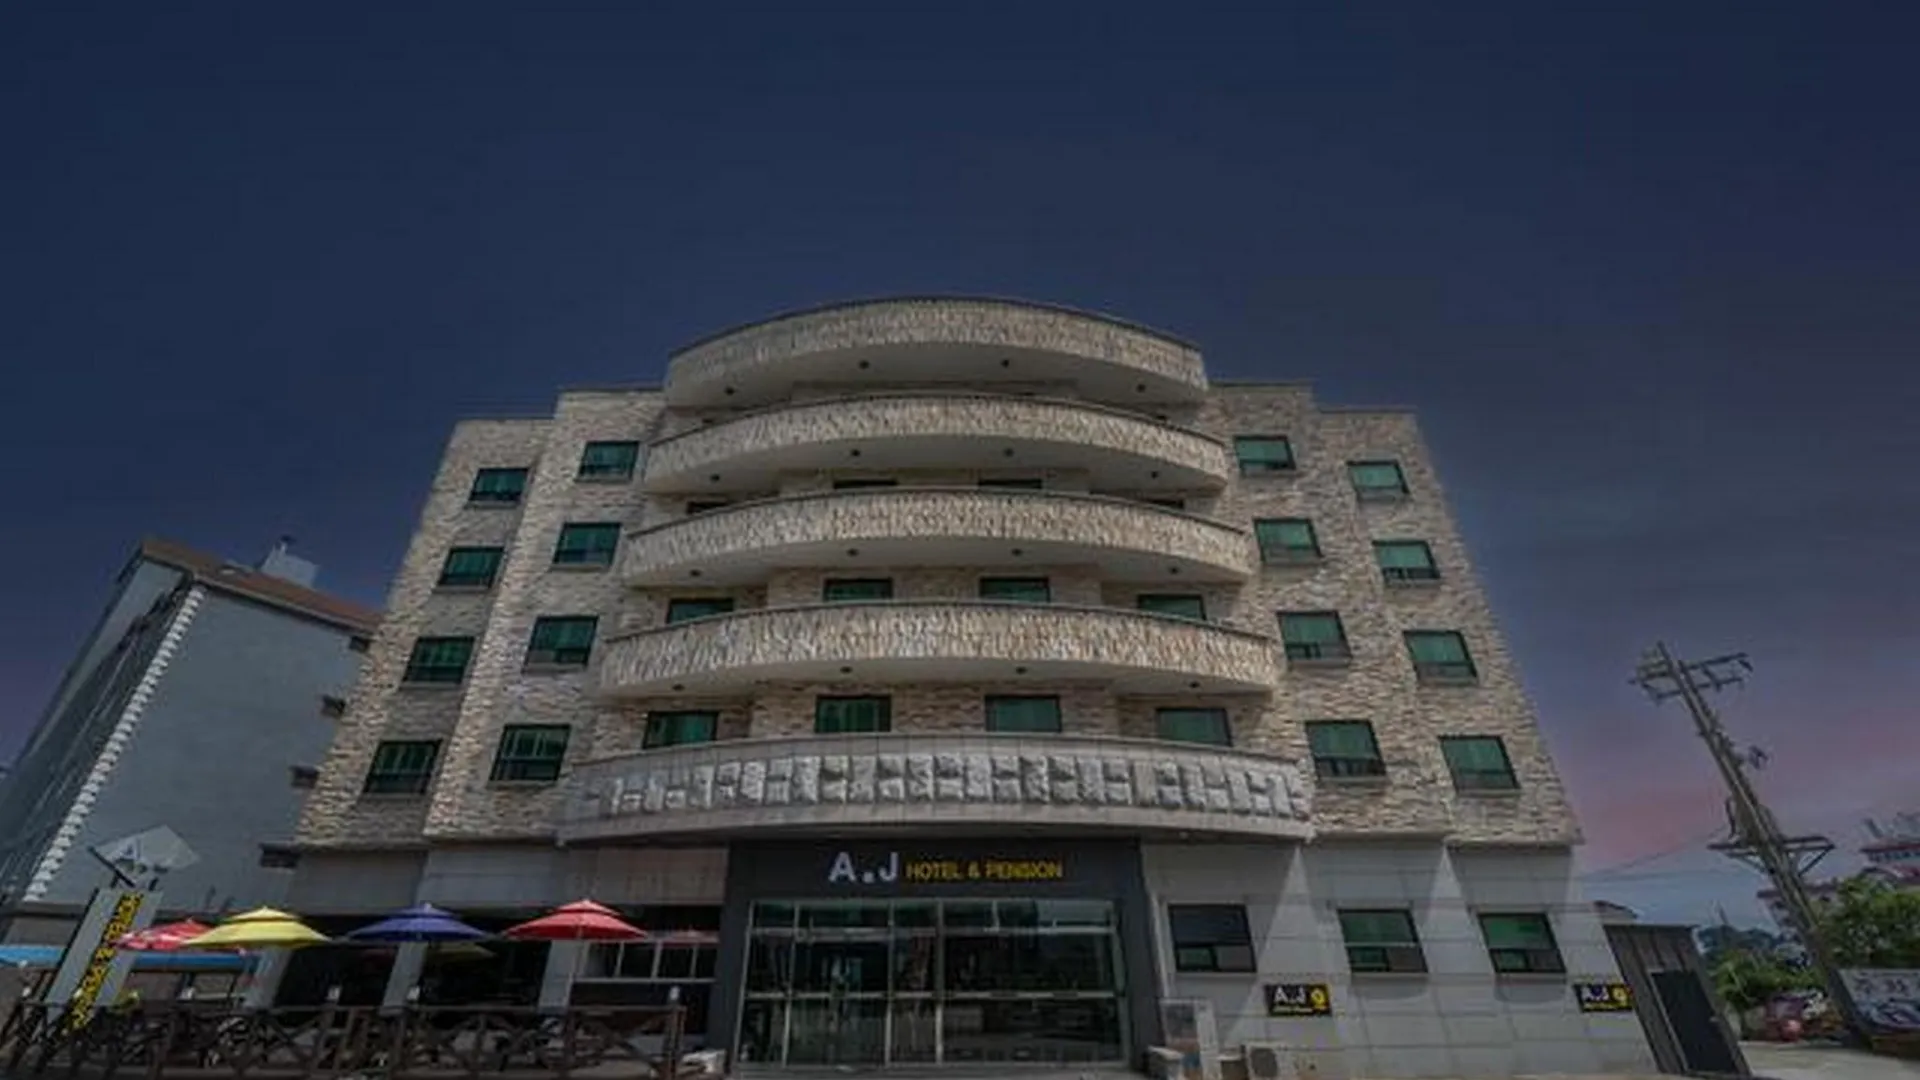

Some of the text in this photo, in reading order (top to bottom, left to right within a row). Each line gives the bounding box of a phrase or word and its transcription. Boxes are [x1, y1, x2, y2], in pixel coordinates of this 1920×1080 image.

[828, 852, 1063, 883] A.J HOTEL & PENSION
